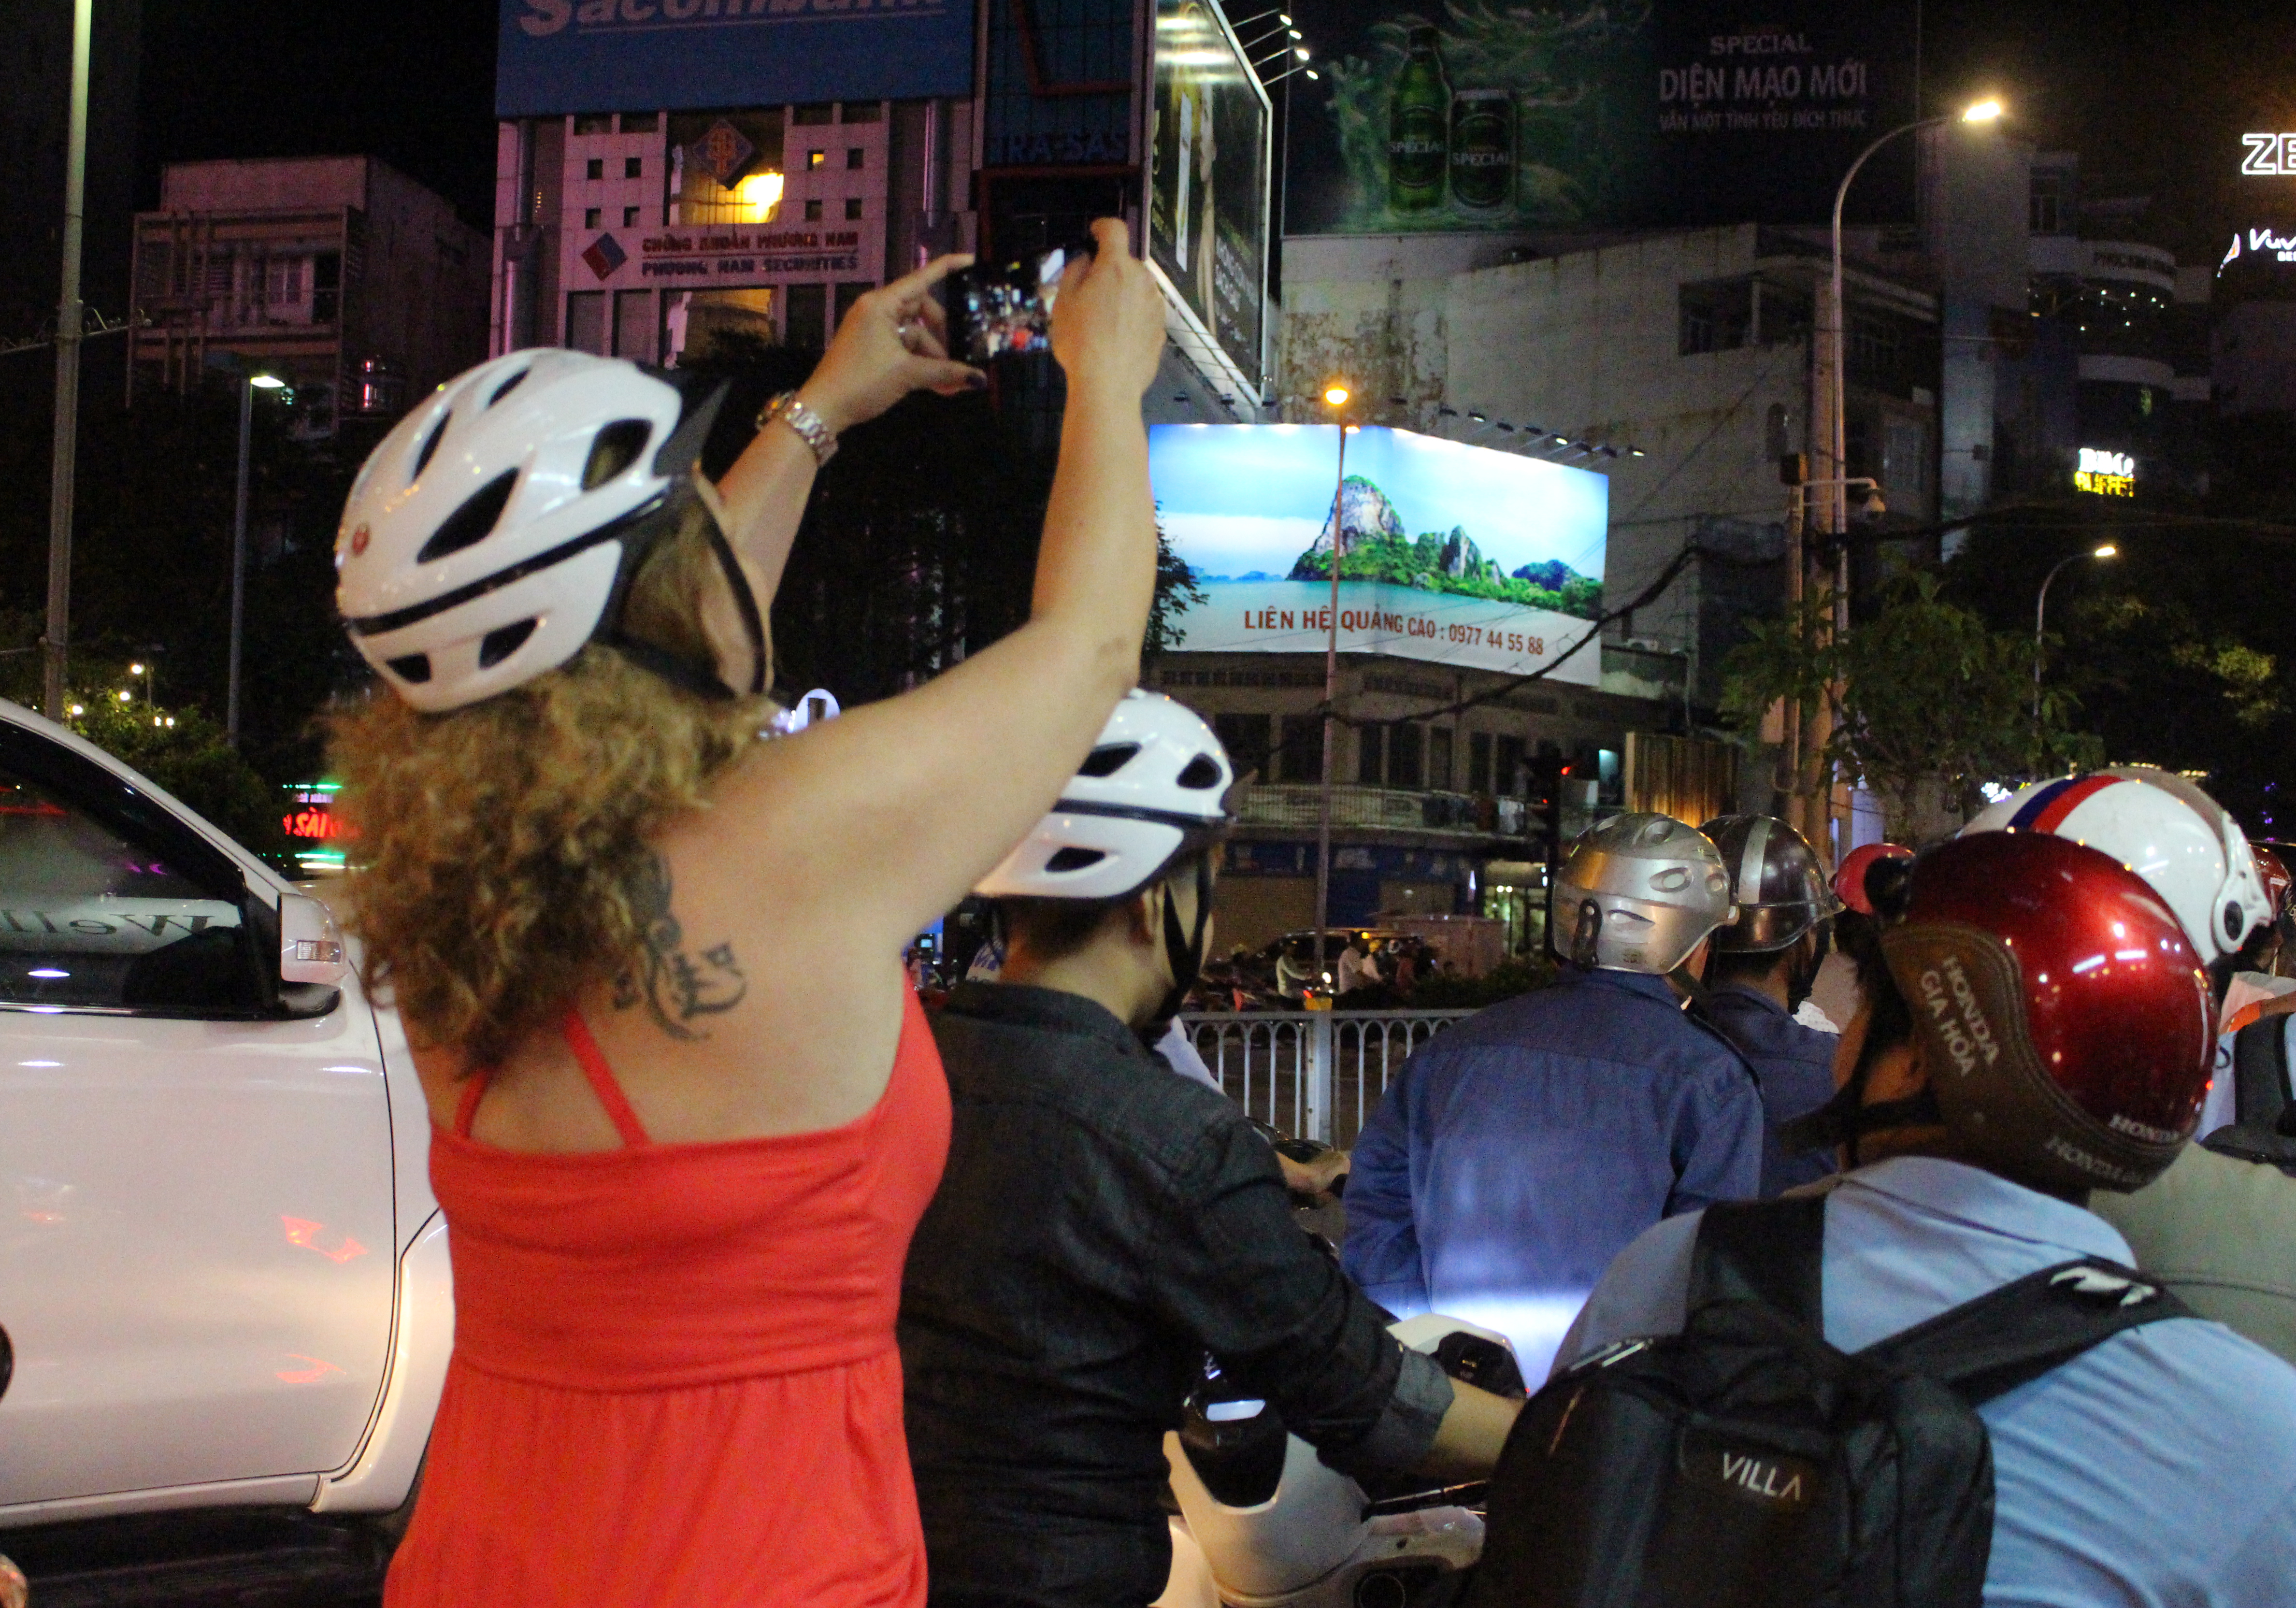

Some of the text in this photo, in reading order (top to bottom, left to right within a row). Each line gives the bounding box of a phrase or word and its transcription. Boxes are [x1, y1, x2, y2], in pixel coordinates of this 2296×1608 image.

[519, 0, 944, 37] Sacom
[1709, 32, 1814, 55] SPECIAL
[1659, 61, 1724, 109] DIỆN
[1734, 65, 1801, 109] MẠO
[717, 258, 755, 273] NAM
[763, 256, 858, 272] SECURITIES
[1244, 605, 1294, 629] LIÊN
[1303, 605, 1332, 633] HỆ
[1449, 623, 1482, 645] 0977
[1486, 630, 1503, 649] 44
[1507, 633, 1523, 652] 55
[1528, 636, 1544, 655] 88
[293, 806, 330, 838] SÀI
[1920, 970, 1949, 1018] GIA
[1942, 956, 2000, 1066] HONDA
[1722, 1451, 1802, 1502] VILLA
